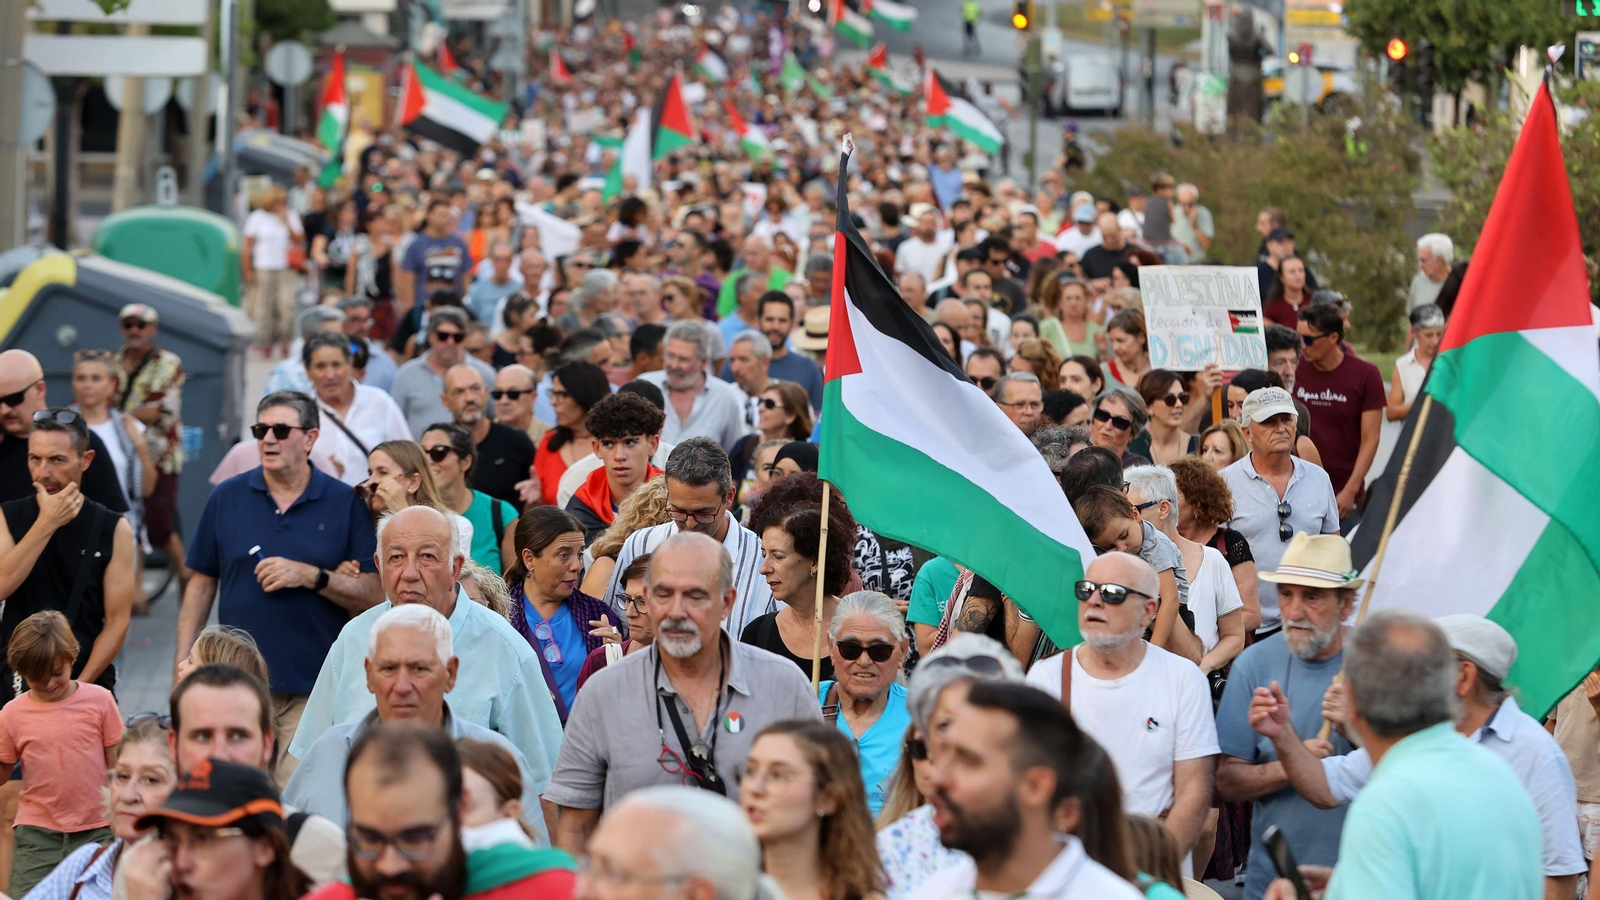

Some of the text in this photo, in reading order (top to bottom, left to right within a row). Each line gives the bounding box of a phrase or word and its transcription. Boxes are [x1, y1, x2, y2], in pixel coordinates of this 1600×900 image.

[1140, 271, 1261, 307] PALESTINA
[1150, 307, 1200, 330] lección
[1205, 310, 1223, 328] de
[1149, 332, 1268, 368] DIGNIDAD
